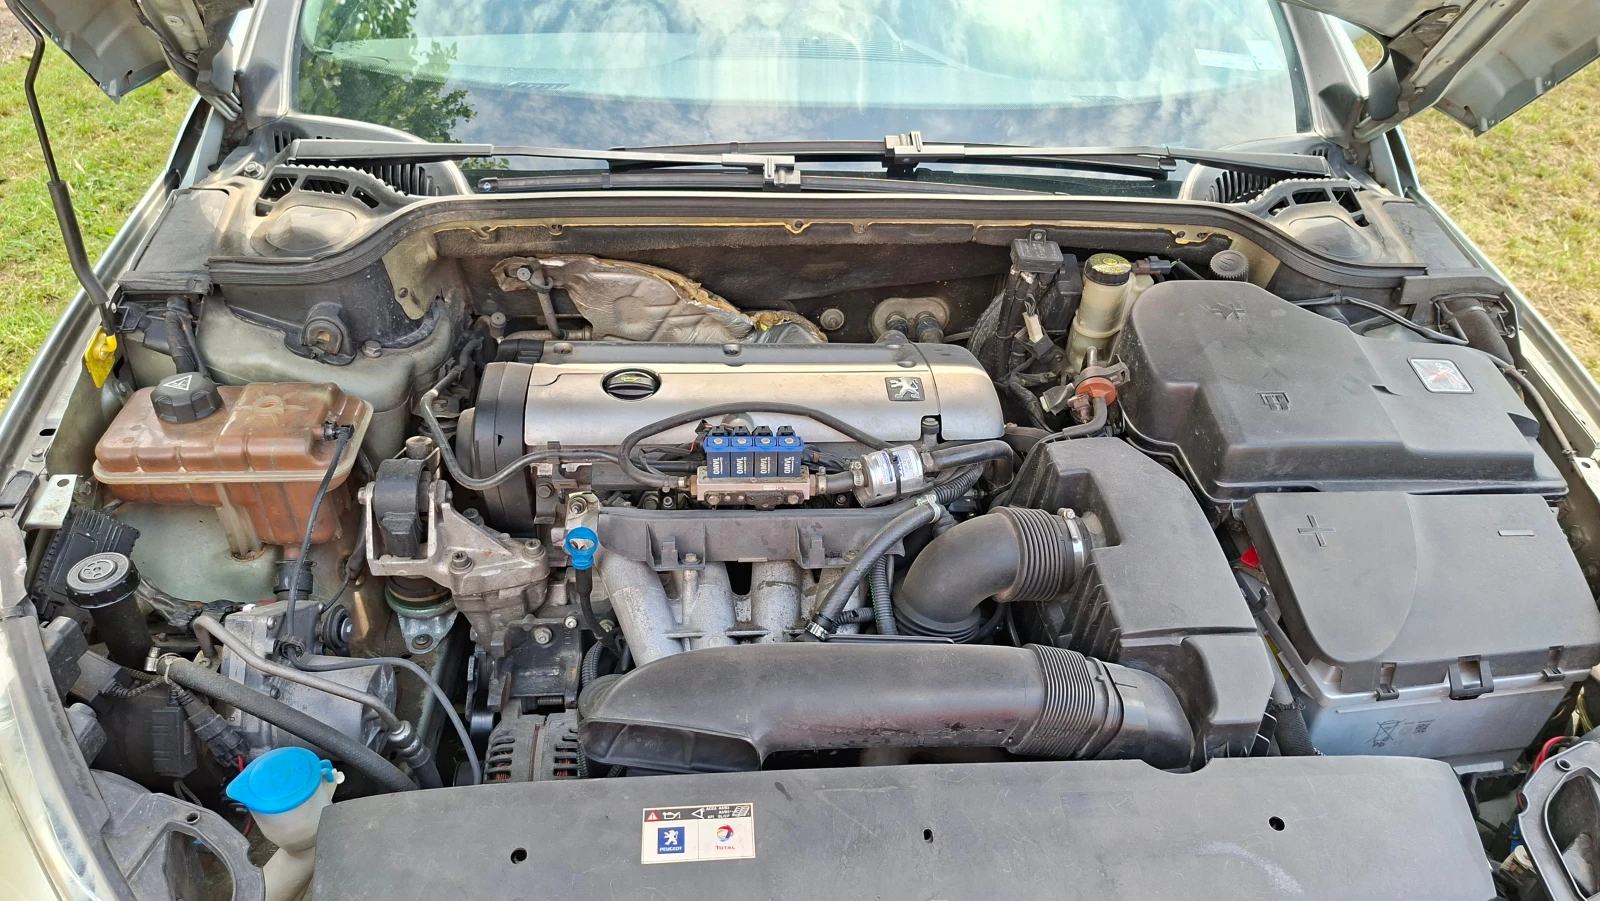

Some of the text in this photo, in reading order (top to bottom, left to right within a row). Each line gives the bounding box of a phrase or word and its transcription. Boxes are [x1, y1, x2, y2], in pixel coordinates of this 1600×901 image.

[712, 456, 720, 475] OMVL
[736, 456, 744, 475] OMVL
[760, 456, 768, 475] OMVL
[783, 456, 792, 474] OMVL
